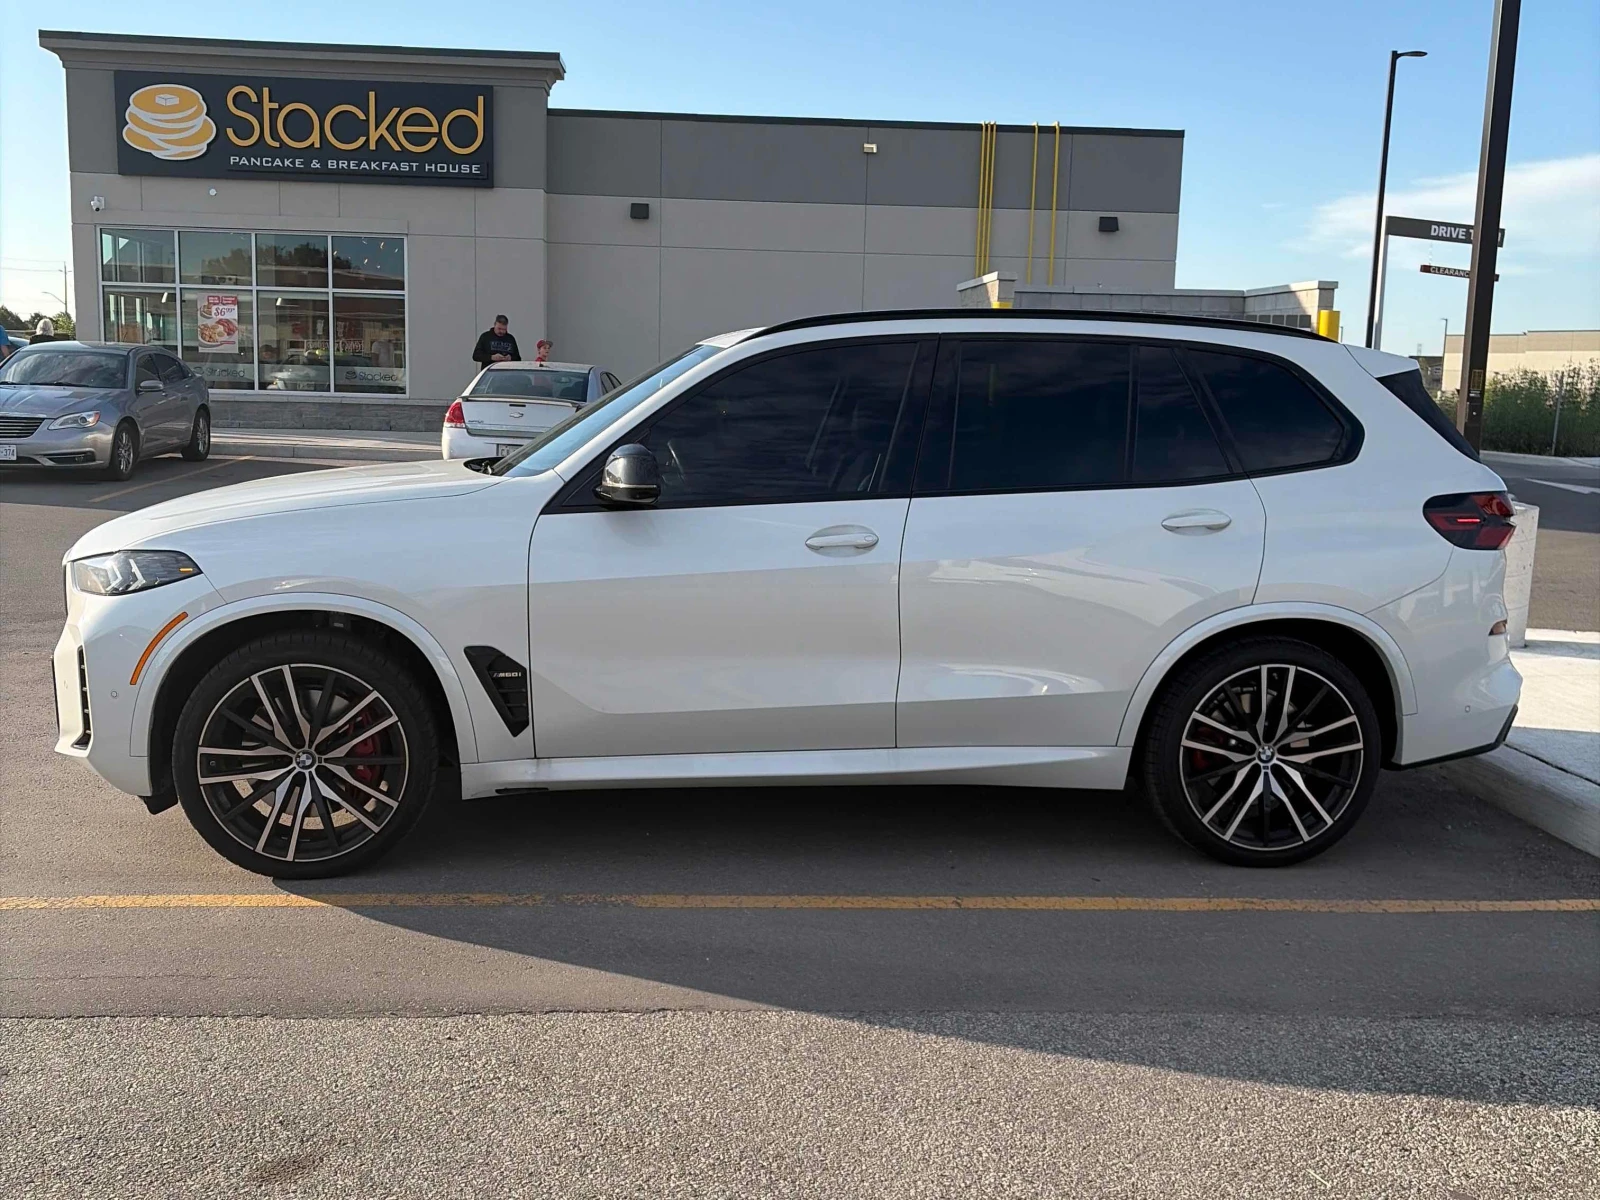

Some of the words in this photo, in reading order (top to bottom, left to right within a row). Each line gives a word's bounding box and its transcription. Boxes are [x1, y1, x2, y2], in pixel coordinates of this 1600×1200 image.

[226, 85, 484, 155] Stacked
[230, 156, 304, 168] PANCAKE
[310, 159, 321, 169] &
[327, 160, 419, 172] BREAKFAST
[425, 163, 481, 174] HOUSE
[1430, 225, 1467, 239] DRIVE
[1430, 266, 1470, 278] CLEARANC
